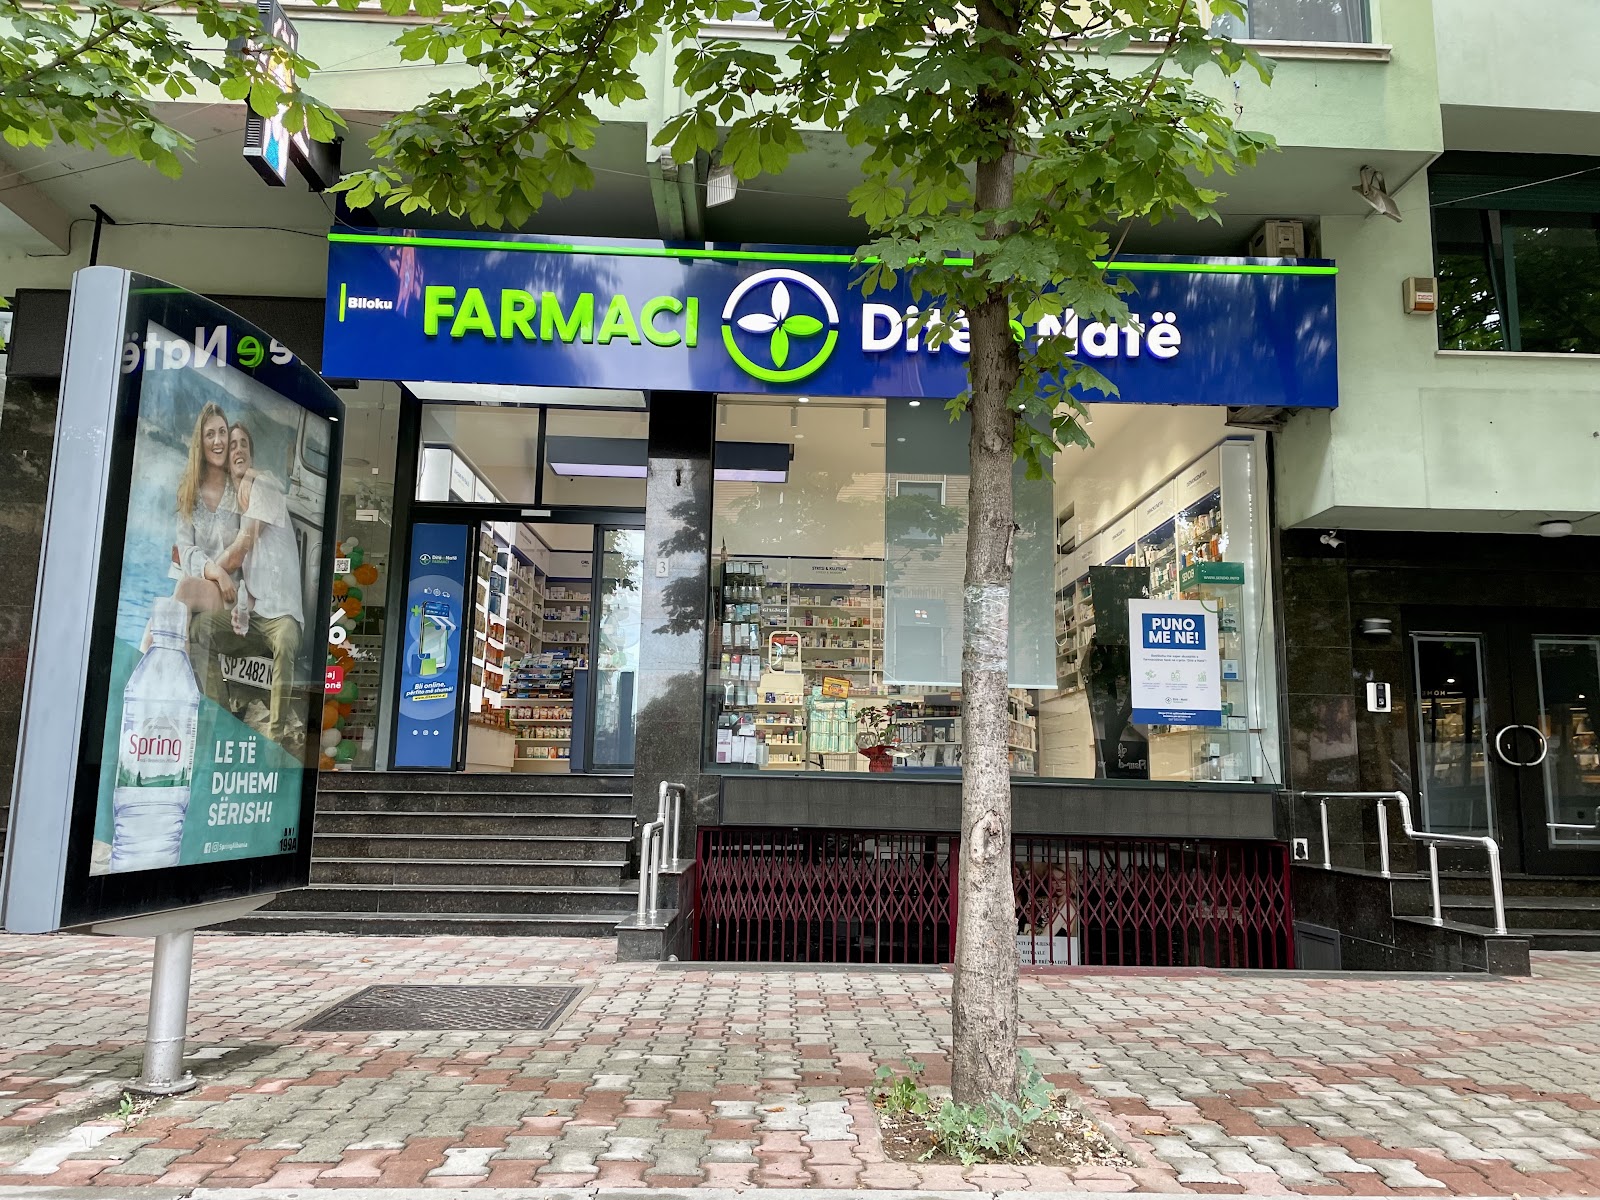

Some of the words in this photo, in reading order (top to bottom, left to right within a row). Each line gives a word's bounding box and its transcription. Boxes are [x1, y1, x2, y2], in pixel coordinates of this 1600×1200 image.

[423, 285, 699, 348] FARMACI
[1037, 306, 1182, 357] Natë
[659, 561, 666, 573] 3
[1149, 631, 1171, 644] ME
[1175, 632, 1200, 645] NE!
[1152, 618, 1196, 631] PUNO
[239, 658, 266, 683] 2482
[128, 734, 182, 763] Spring
[214, 740, 235, 764] LE
[238, 735, 257, 764] TË
[211, 771, 279, 795] DUHEMI
[207, 796, 273, 827] SËRISH!
